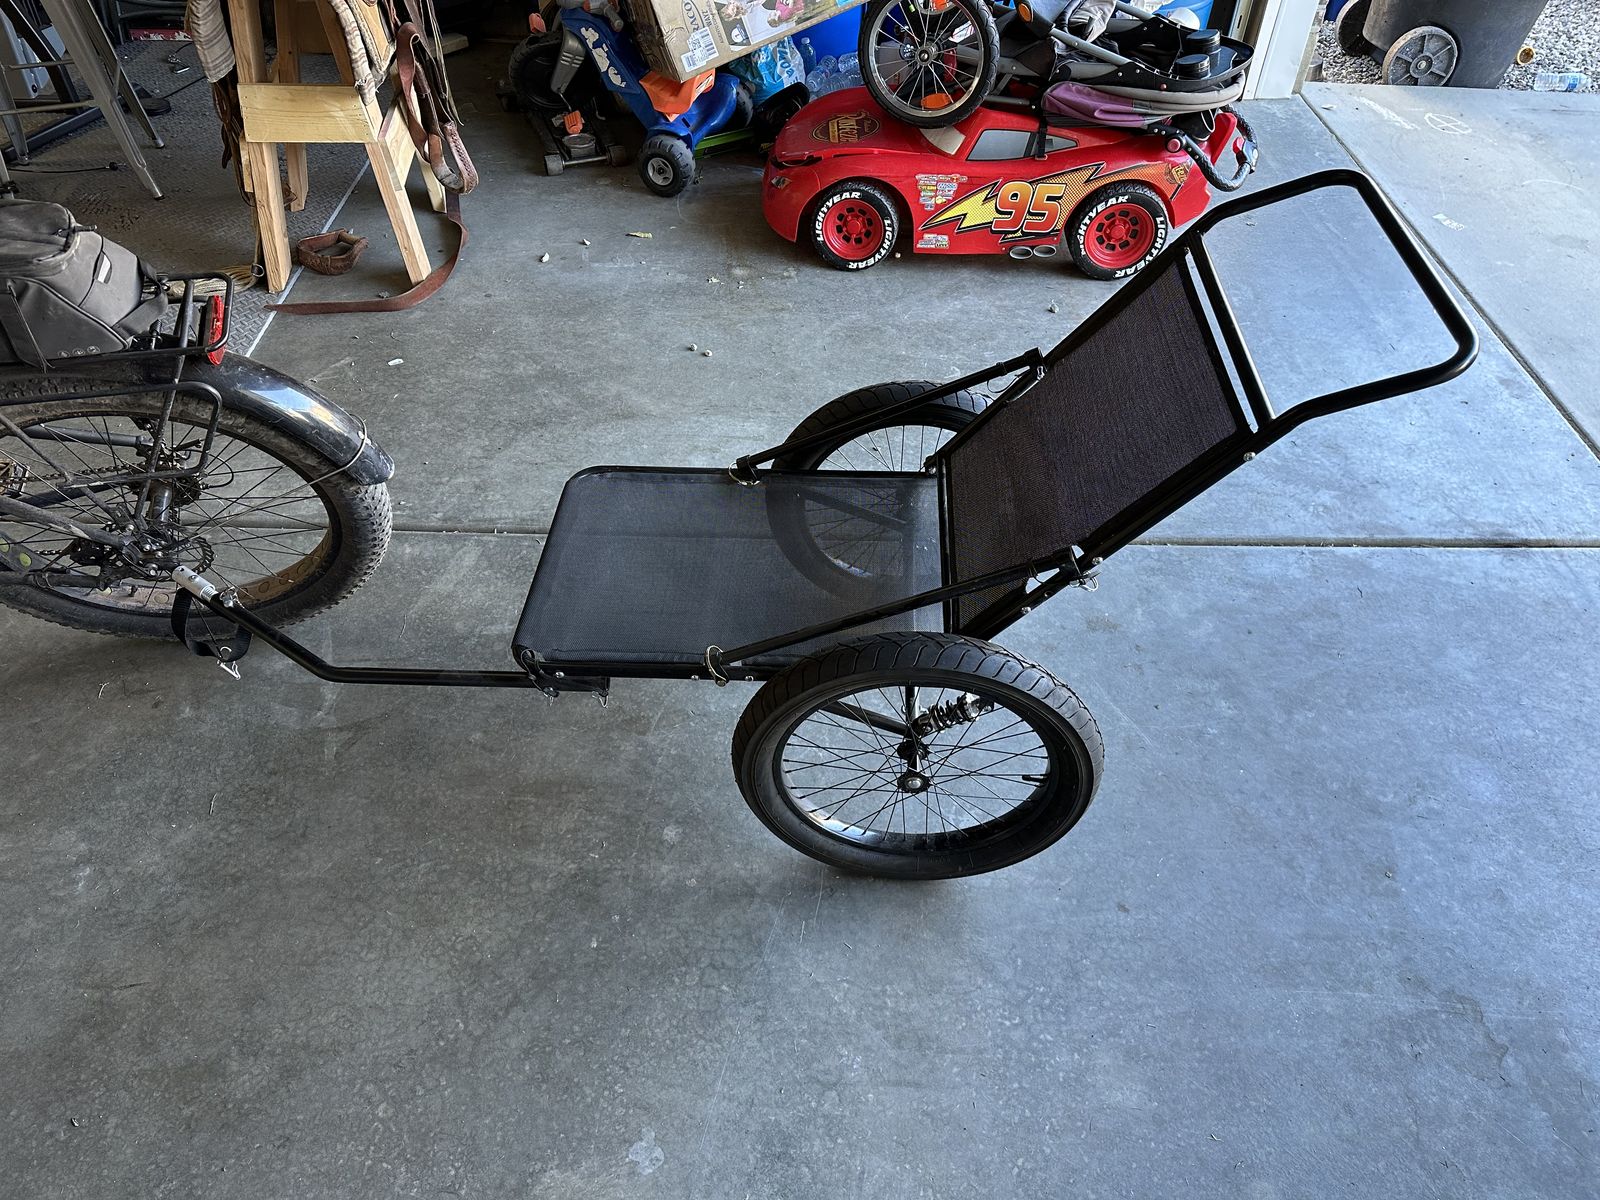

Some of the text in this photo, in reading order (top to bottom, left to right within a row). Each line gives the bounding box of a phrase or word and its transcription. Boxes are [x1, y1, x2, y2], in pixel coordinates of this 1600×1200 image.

[815, 191, 861, 242] LIGHTYEAR
[992, 181, 1066, 233] 95
[1077, 195, 1129, 255] LIGHTYEAR
[848, 218, 893, 269] LIGHTYEAR
[1114, 216, 1166, 278] LIGHTYEAR
